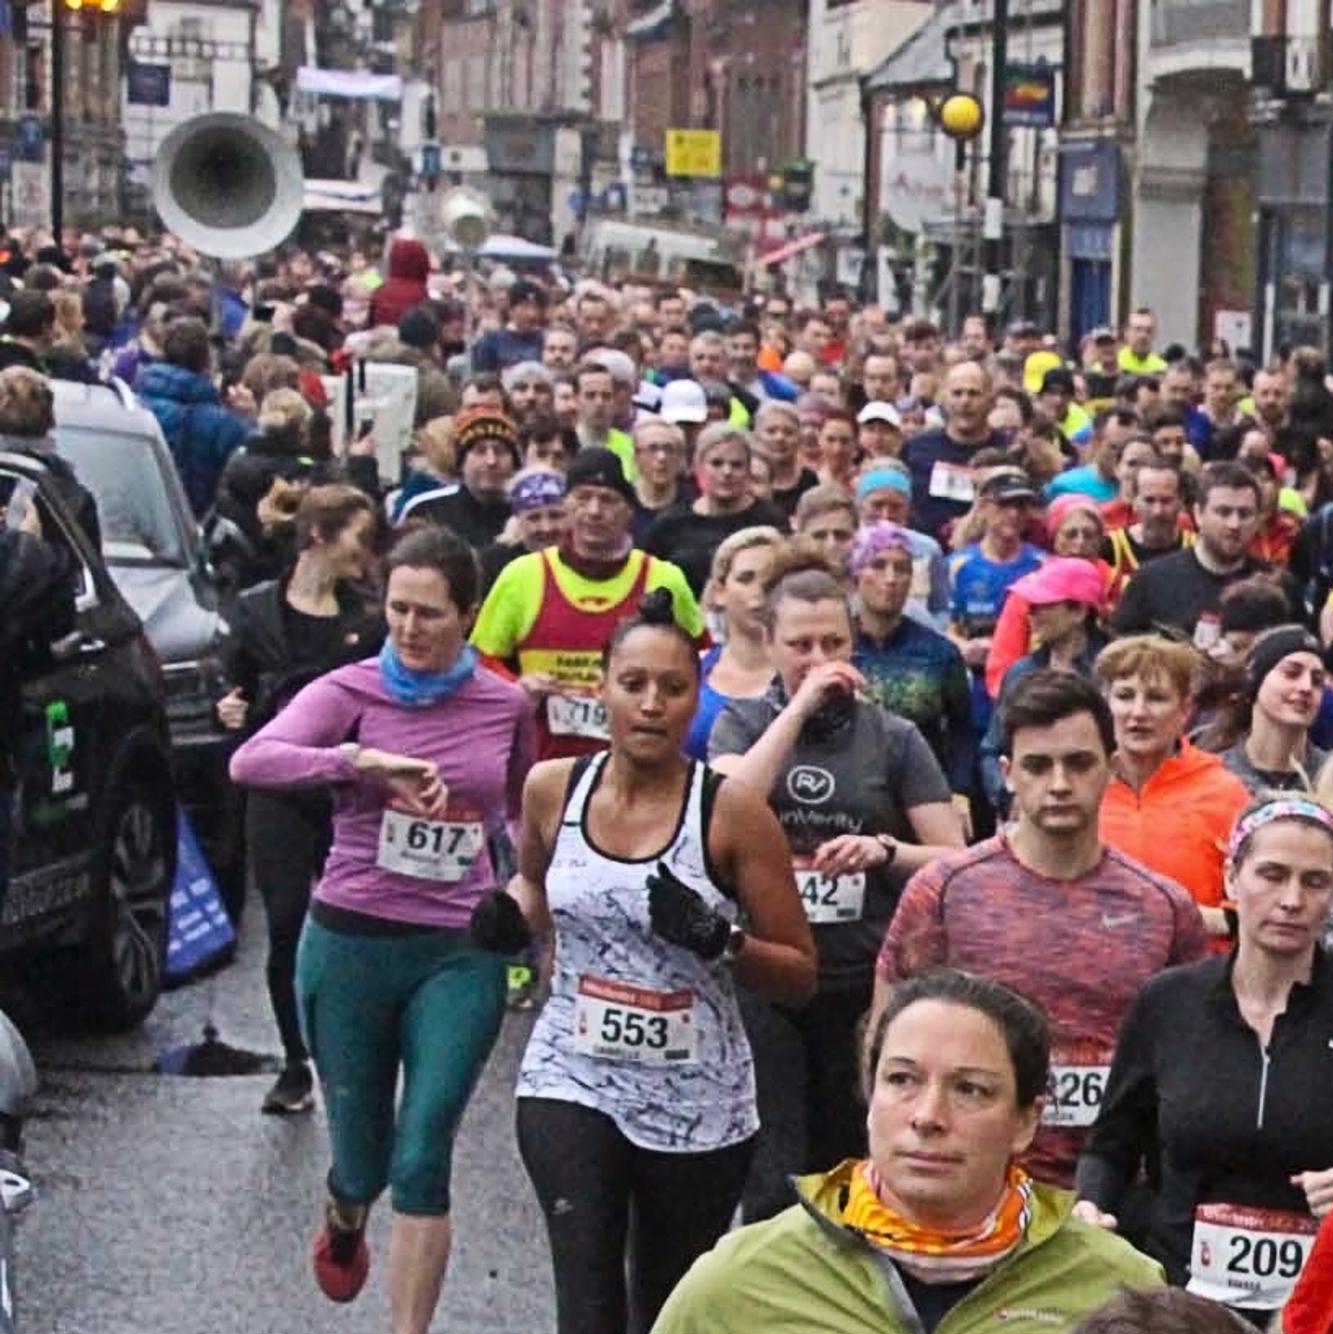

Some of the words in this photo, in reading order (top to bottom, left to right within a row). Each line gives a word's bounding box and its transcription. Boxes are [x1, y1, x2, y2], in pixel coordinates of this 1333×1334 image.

[408, 822, 466, 854] 617
[601, 1008, 668, 1049] 553
[1227, 1235, 1303, 1279] 209
